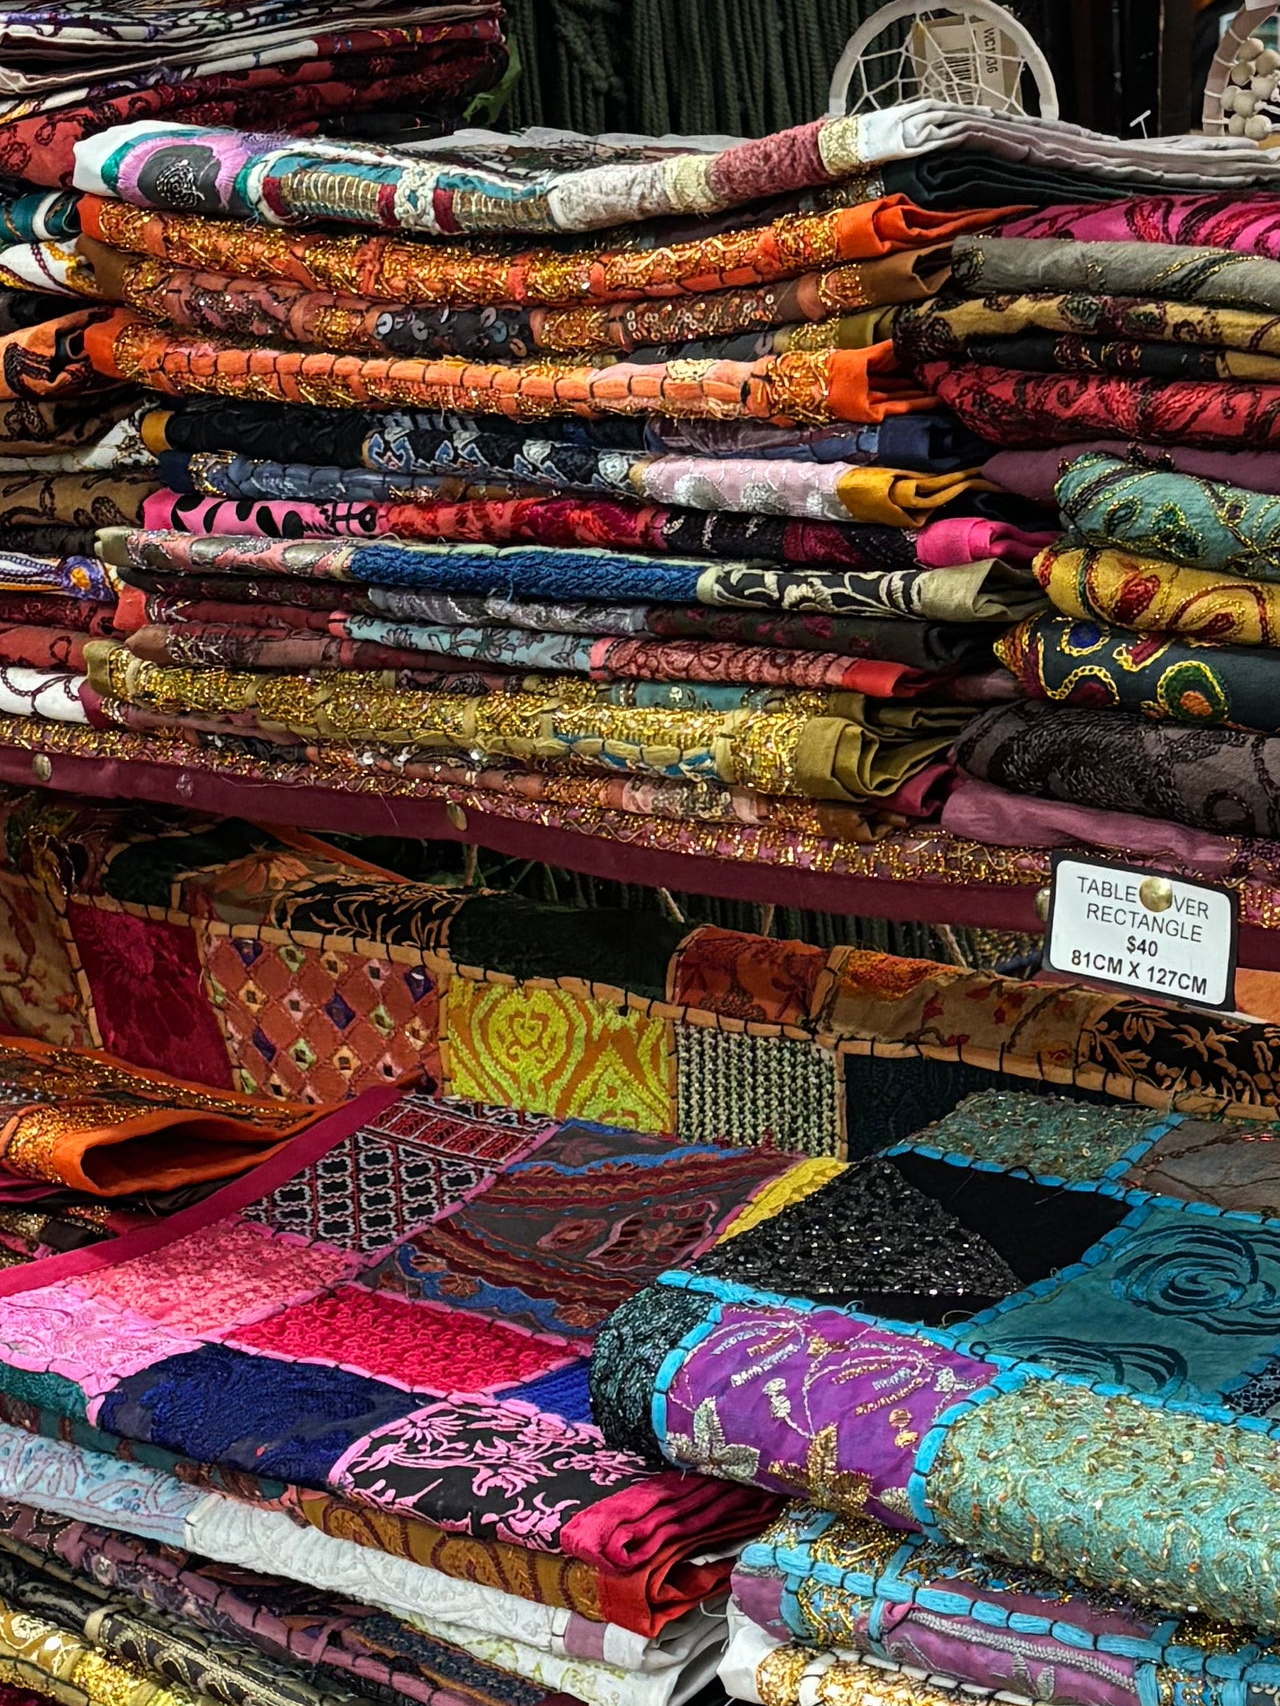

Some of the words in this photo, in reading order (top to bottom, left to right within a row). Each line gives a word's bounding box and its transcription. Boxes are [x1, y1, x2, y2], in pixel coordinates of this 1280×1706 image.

[1077, 875, 1137, 904] TABLE
[1169, 894, 1210, 921] VER
[1086, 903, 1203, 943] RECTANGLE
[1125, 935, 1159, 958] $40
[1071, 949, 1124, 976] 81CM
[1127, 960, 1141, 979] X
[1146, 966, 1208, 996] 127CM
